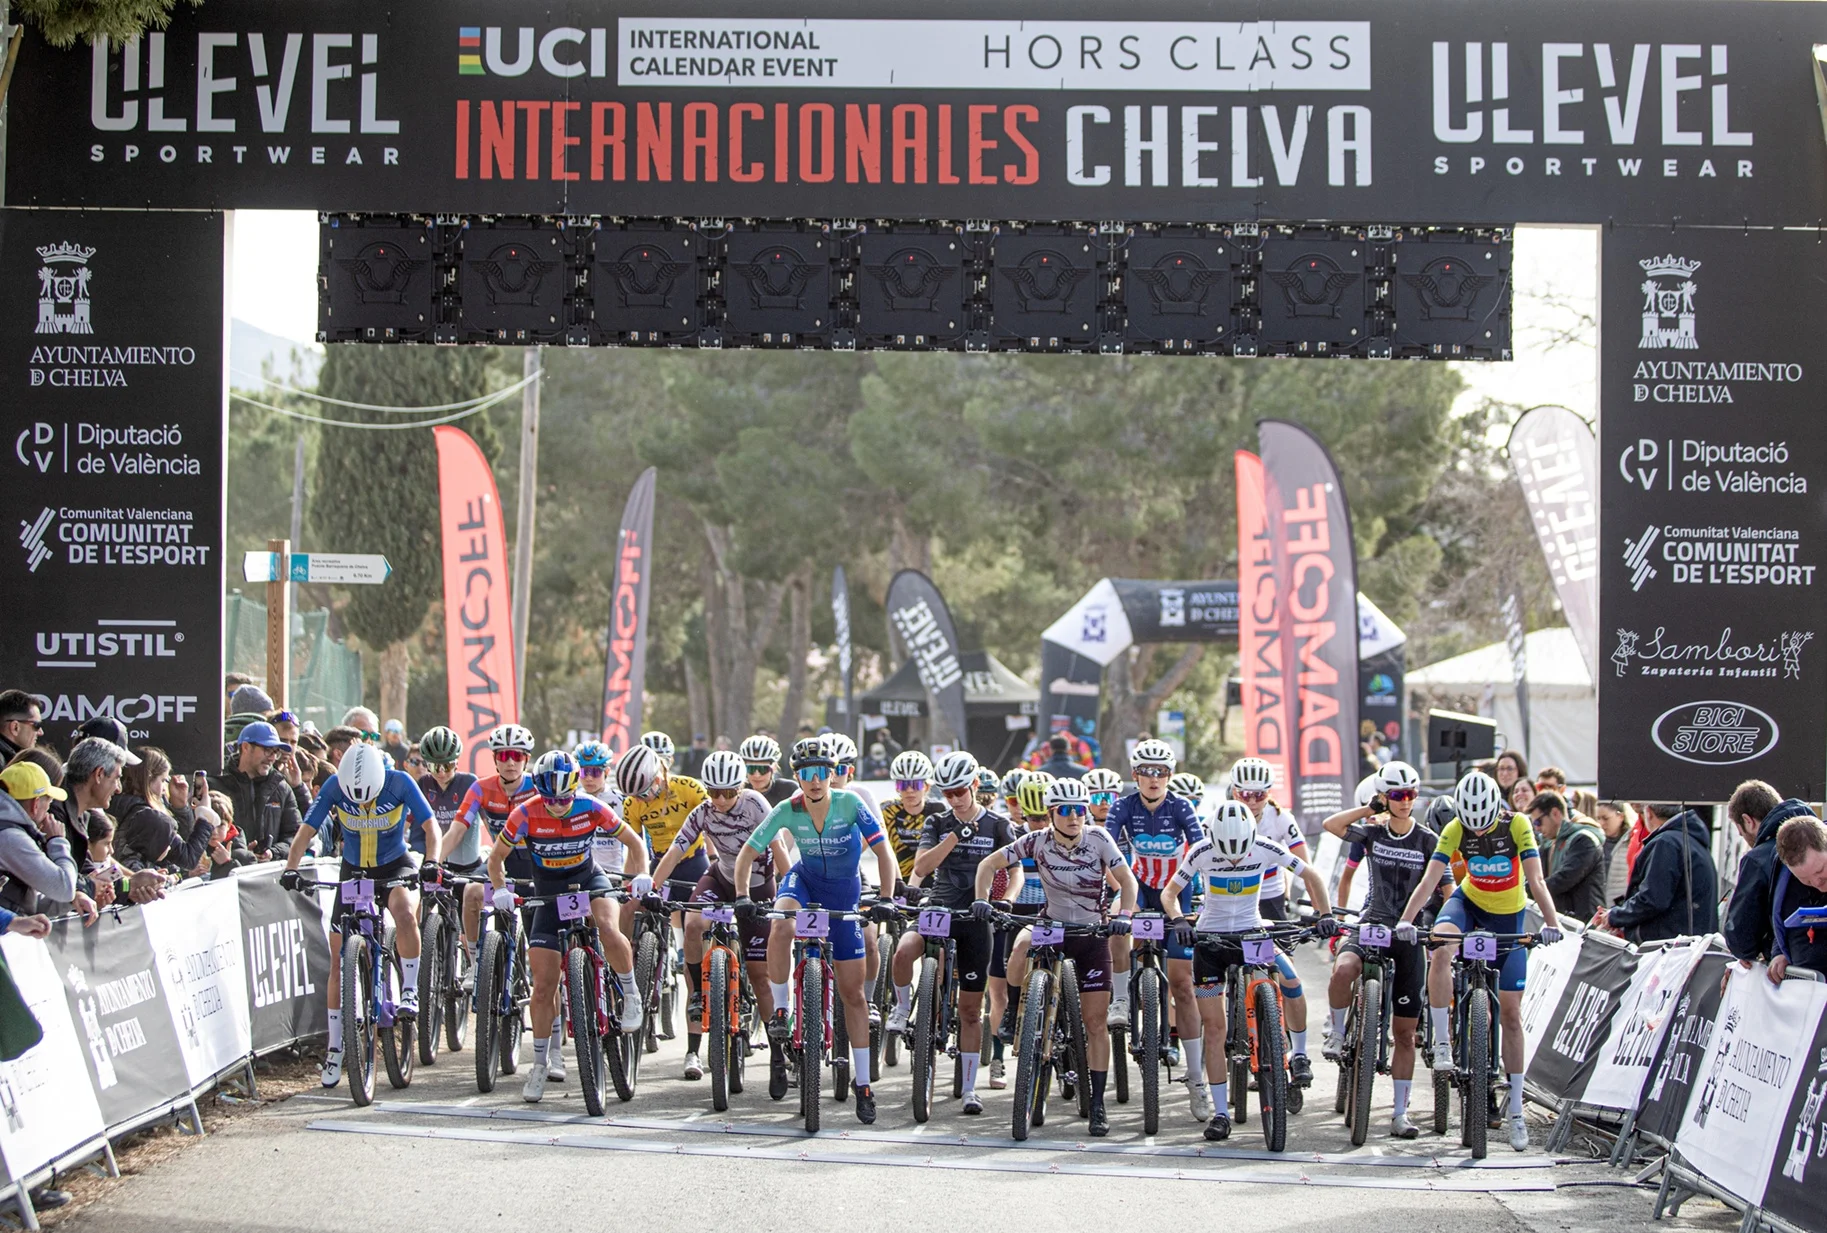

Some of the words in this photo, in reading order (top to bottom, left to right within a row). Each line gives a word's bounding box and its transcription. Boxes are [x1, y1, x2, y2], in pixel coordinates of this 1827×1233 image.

[630, 30, 820, 51] INTERNATIONAL
[484, 27, 606, 78] UCI
[984, 34, 1141, 71] HORS
[1170, 35, 1351, 72] CLASS
[630, 56, 757, 77] CALENDAR
[763, 57, 838, 78] EVENT
[91, 33, 400, 134] ULEVEL
[1433, 41, 1753, 147] ULEVEL
[456, 100, 1040, 186] INTERNACIONALES
[1066, 105, 1372, 188] CHELVA
[90, 144, 399, 166] SPORTWEAR
[1433, 156, 1754, 178] SPORTWEAR
[30, 346, 196, 366] AYUNTAMIENTO
[49, 369, 128, 387] CHELVA
[1633, 360, 1803, 383] AYUNTAMIENTO
[1653, 384, 1734, 404] CHELVA
[78, 423, 182, 449] Diputació
[77, 453, 105, 474] de
[111, 451, 200, 475] València
[1682, 439, 1789, 468] Diputació
[1681, 469, 1712, 492] de
[1715, 469, 1808, 494] València
[59, 507, 124, 520] Comunitat
[126, 507, 193, 521] Valenciana
[58, 523, 193, 544] COMUNITAT
[1663, 525, 1729, 539] Comunitat
[1732, 526, 1800, 540] Valenciana
[69, 544, 98, 564] DE
[105, 544, 210, 566] L'ESPORT
[1662, 540, 1799, 563] COMUNITAT
[1672, 563, 1704, 584] DE
[1709, 563, 1817, 586] L'ESPORT
[1637, 626, 1782, 663] Sambori
[1718, 666, 1778, 679] Infantil
[1692, 706, 1748, 727] BICI
[1671, 732, 1758, 754] STORE
[671, 776, 708, 801] ROUVY
[640, 801, 689, 823] ROUVY
[532, 835, 594, 852] TREK
[1135, 840, 1175, 851] KMC
[1373, 845, 1424, 860] cannondale
[1373, 856, 1396, 867] FACTORY
[1470, 862, 1510, 873] KMC
[353, 881, 361, 895] 1
[568, 895, 579, 911] 3
[806, 913, 818, 929] 2
[925, 912, 945, 928] 17
[1142, 920, 1153, 932] 9
[1365, 927, 1386, 940] 15
[1252, 942, 1263, 957] 7
[1474, 937, 1486, 952] 8
[249, 918, 316, 1008] ULEVEL
